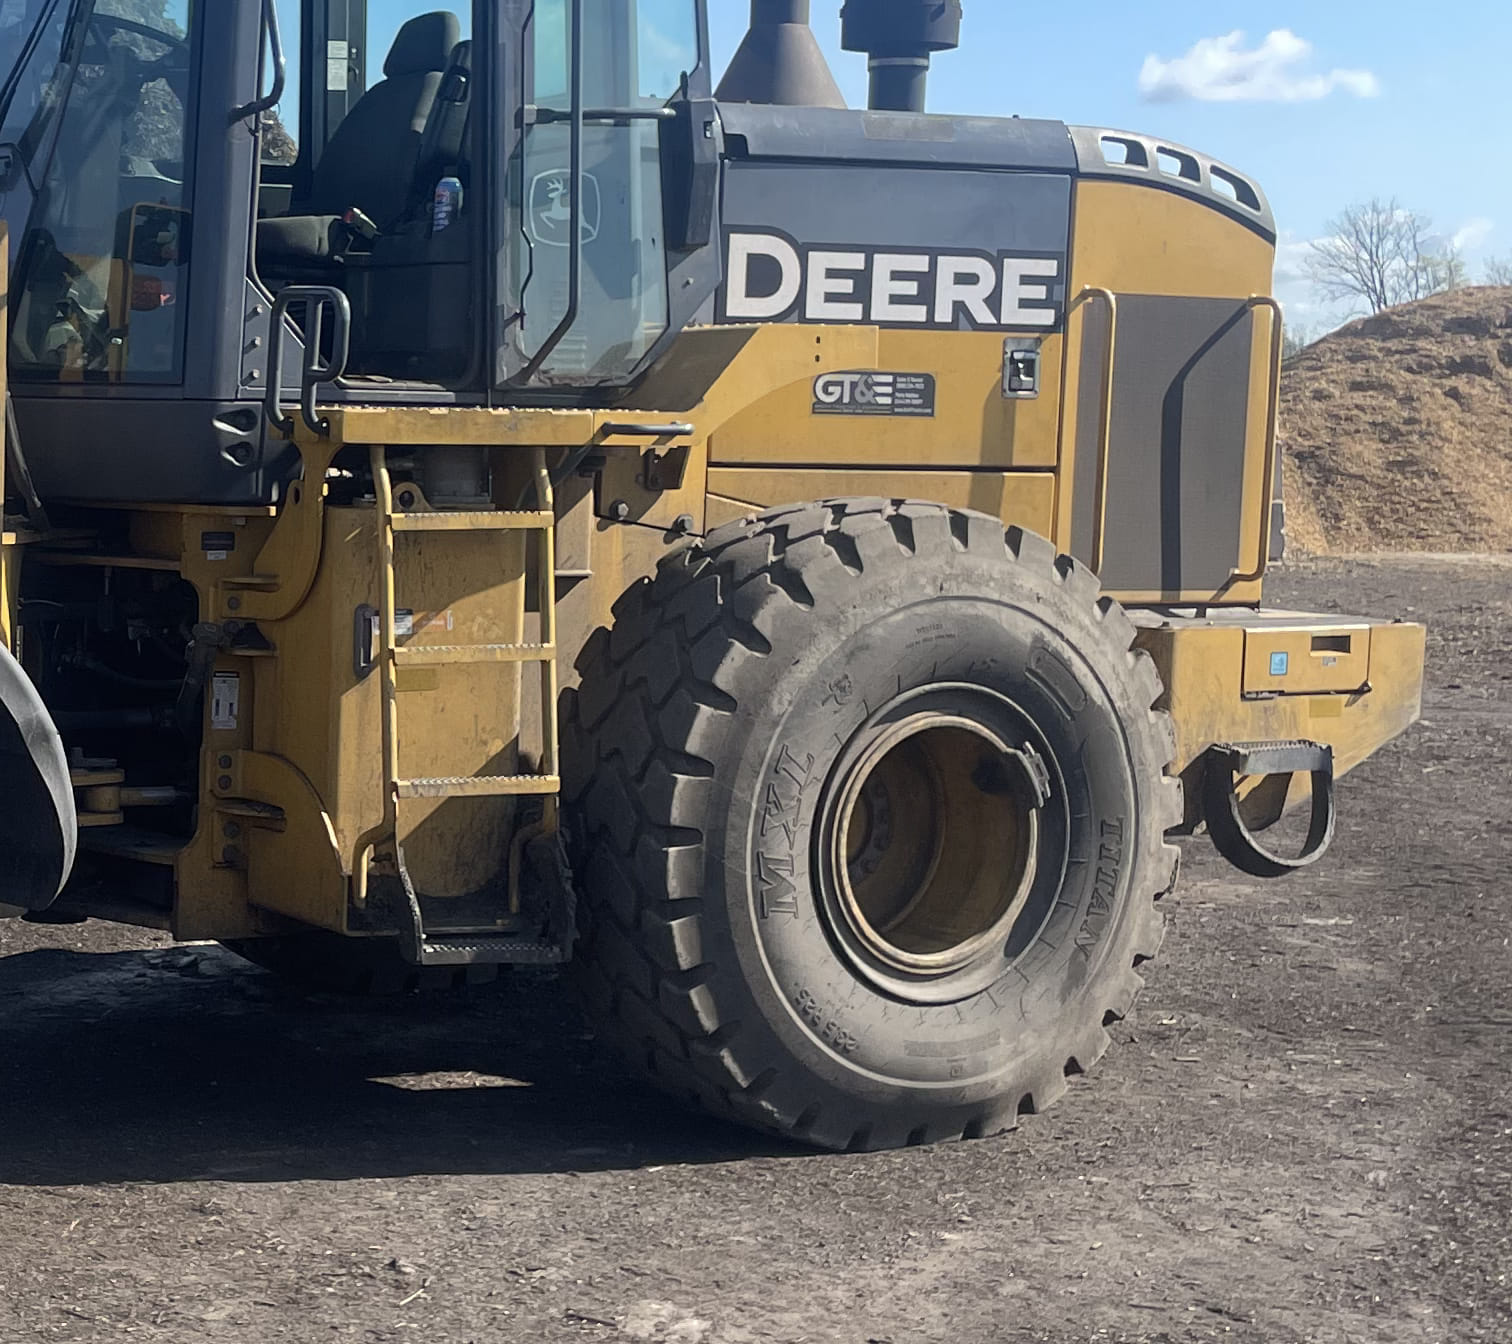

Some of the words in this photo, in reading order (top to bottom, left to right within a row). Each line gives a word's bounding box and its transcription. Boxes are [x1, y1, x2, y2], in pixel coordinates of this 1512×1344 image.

[726, 233, 1058, 326] DEERE
[815, 373, 893, 404] GT&E
[756, 743, 815, 920] MXL
[1074, 817, 1124, 962] TITAN
